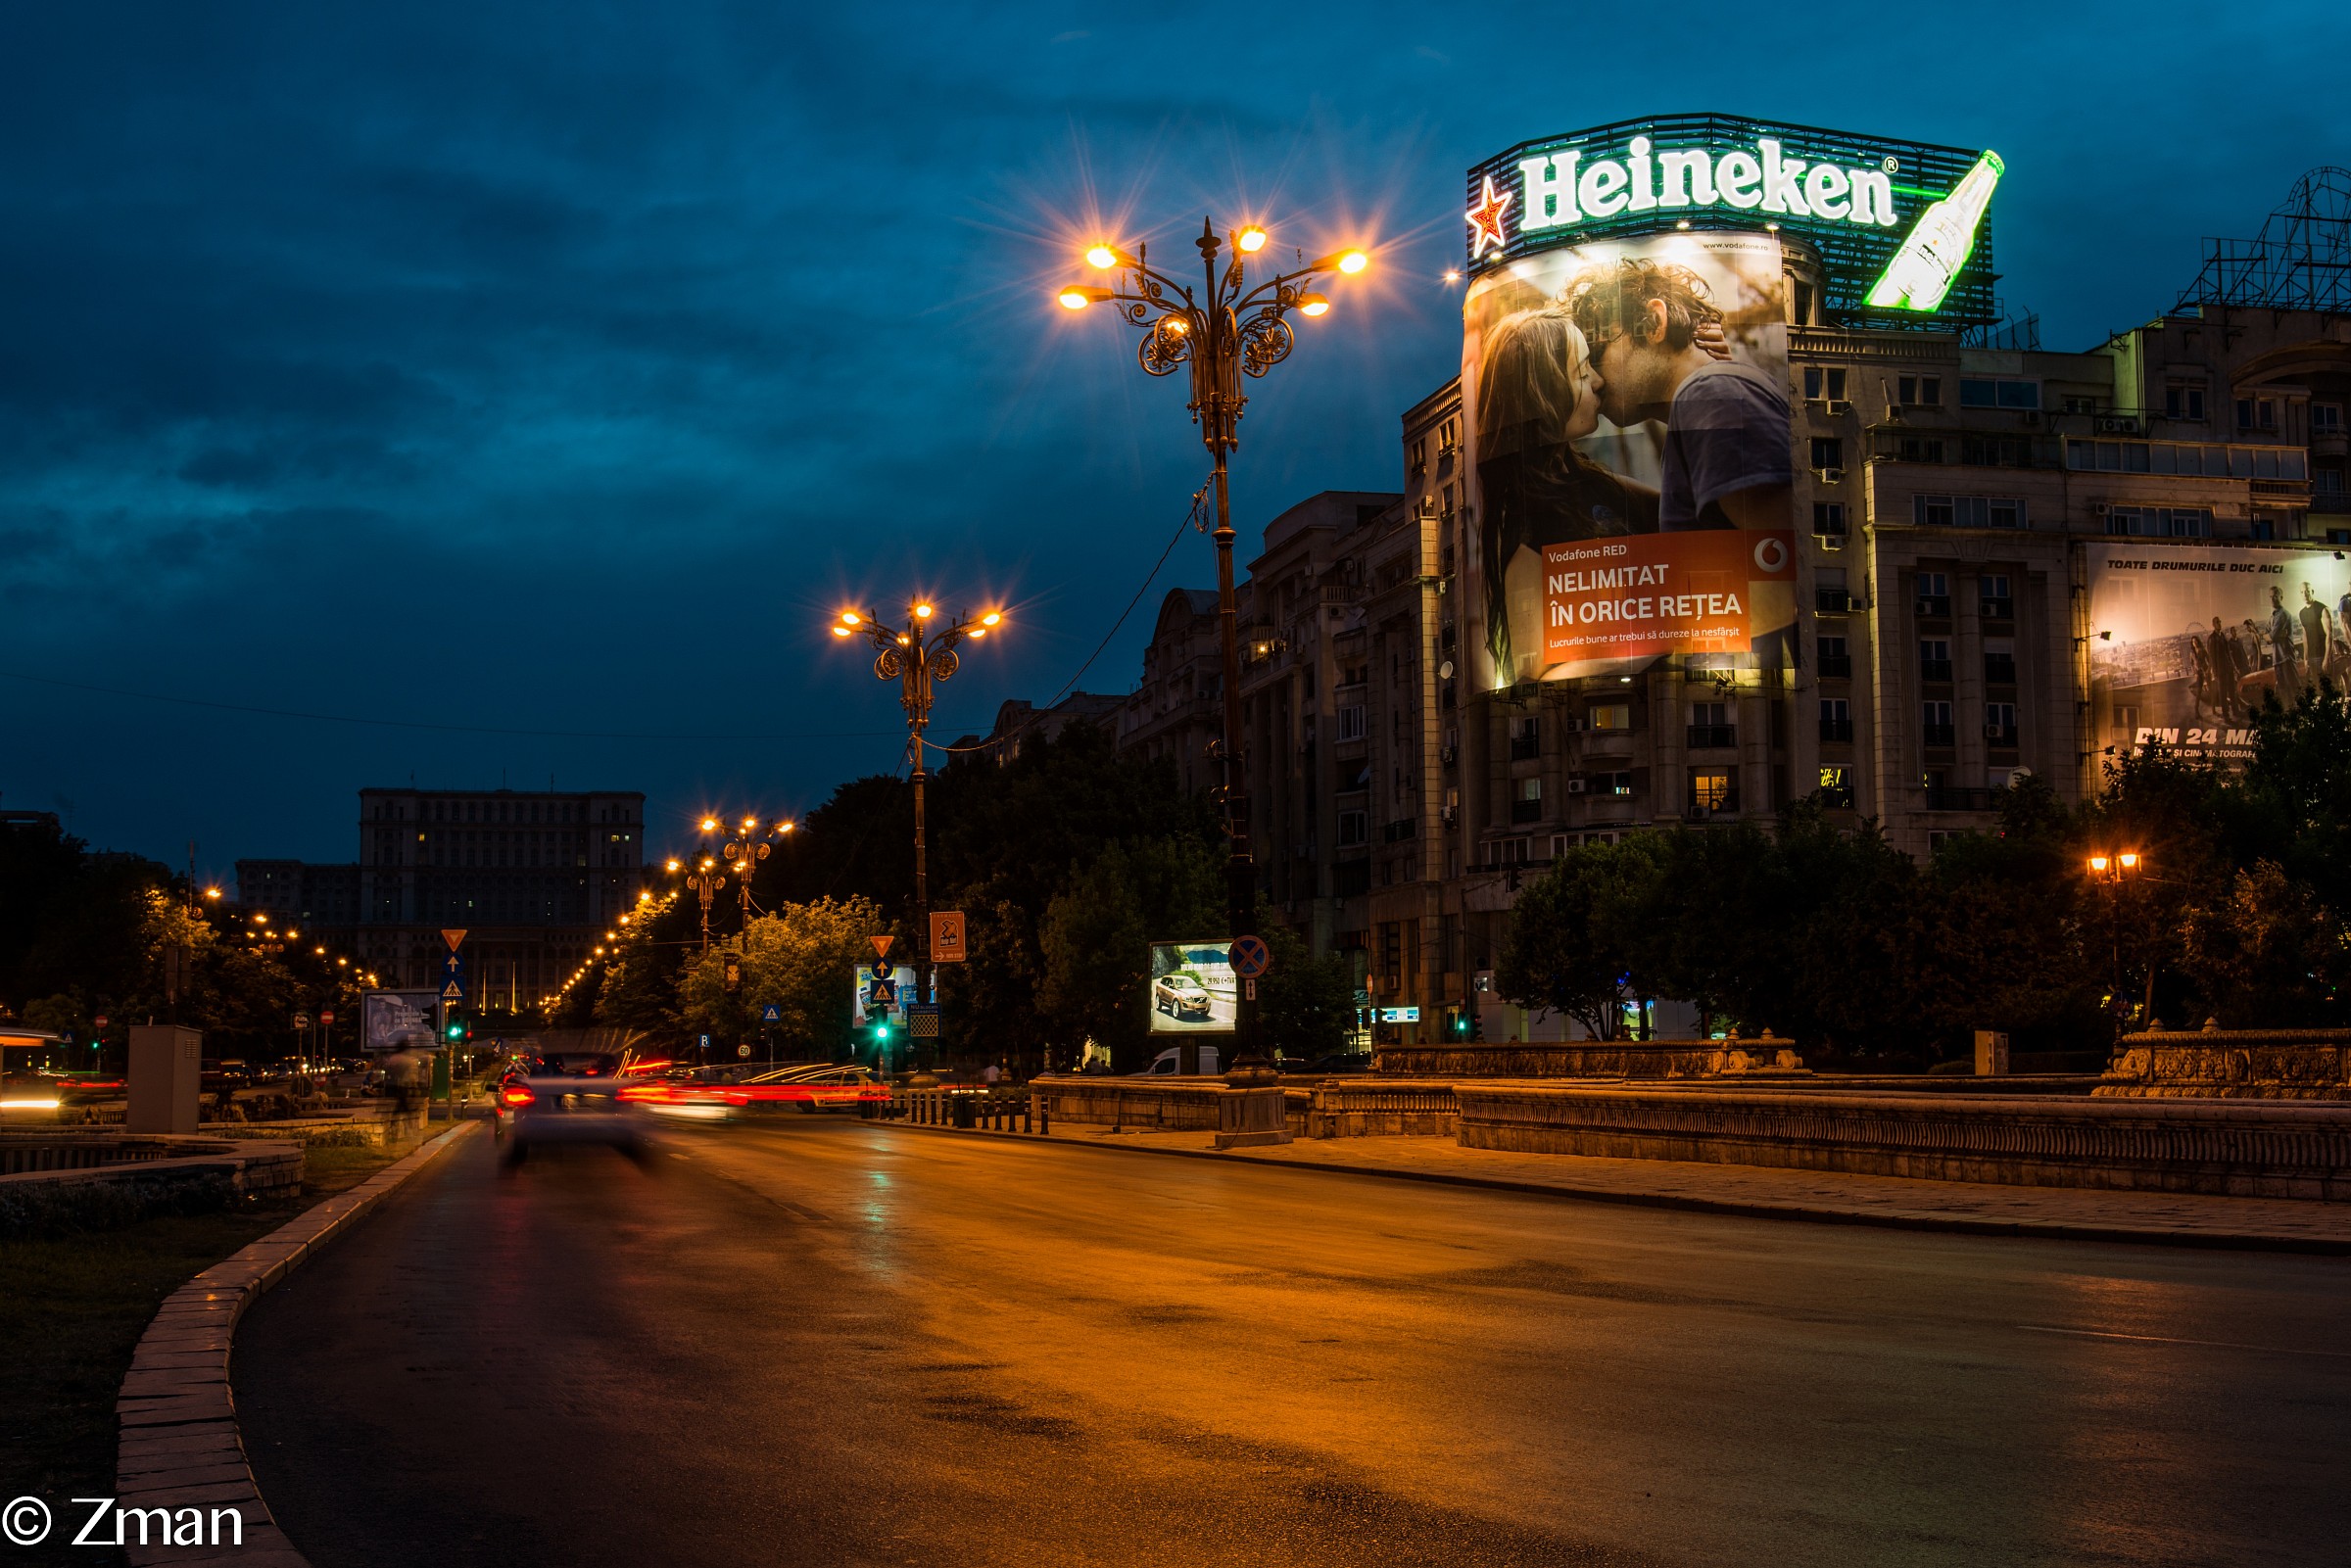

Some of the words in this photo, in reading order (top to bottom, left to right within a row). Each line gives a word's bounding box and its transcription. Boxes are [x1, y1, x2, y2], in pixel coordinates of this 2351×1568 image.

[1519, 137, 1897, 231] Heineken
[1703, 242, 1769, 251] www.vodafone.ro
[1549, 547, 1601, 563] Vodafone
[1603, 545, 1627, 557] RED
[2107, 560, 2147, 570] TOATE
[2151, 561, 2226, 572] DRUMURILE
[2230, 563, 2255, 573] DUC
[2258, 564, 2284, 574] AICI
[1549, 564, 1669, 595] NELIMITAT
[1550, 599, 1573, 627] ÎN
[1579, 596, 1654, 623] ORICE
[1659, 593, 1742, 621] REȚEA
[1550, 635, 1585, 648] Lucrurile
[1586, 633, 1607, 644] bune
[1609, 634, 1618, 642] ar
[1619, 631, 1646, 641] trebui
[1647, 630, 1657, 640] să
[1658, 629, 1690, 640] dureze
[1692, 628, 1700, 638] la
[2185, 728, 2218, 745] 24
